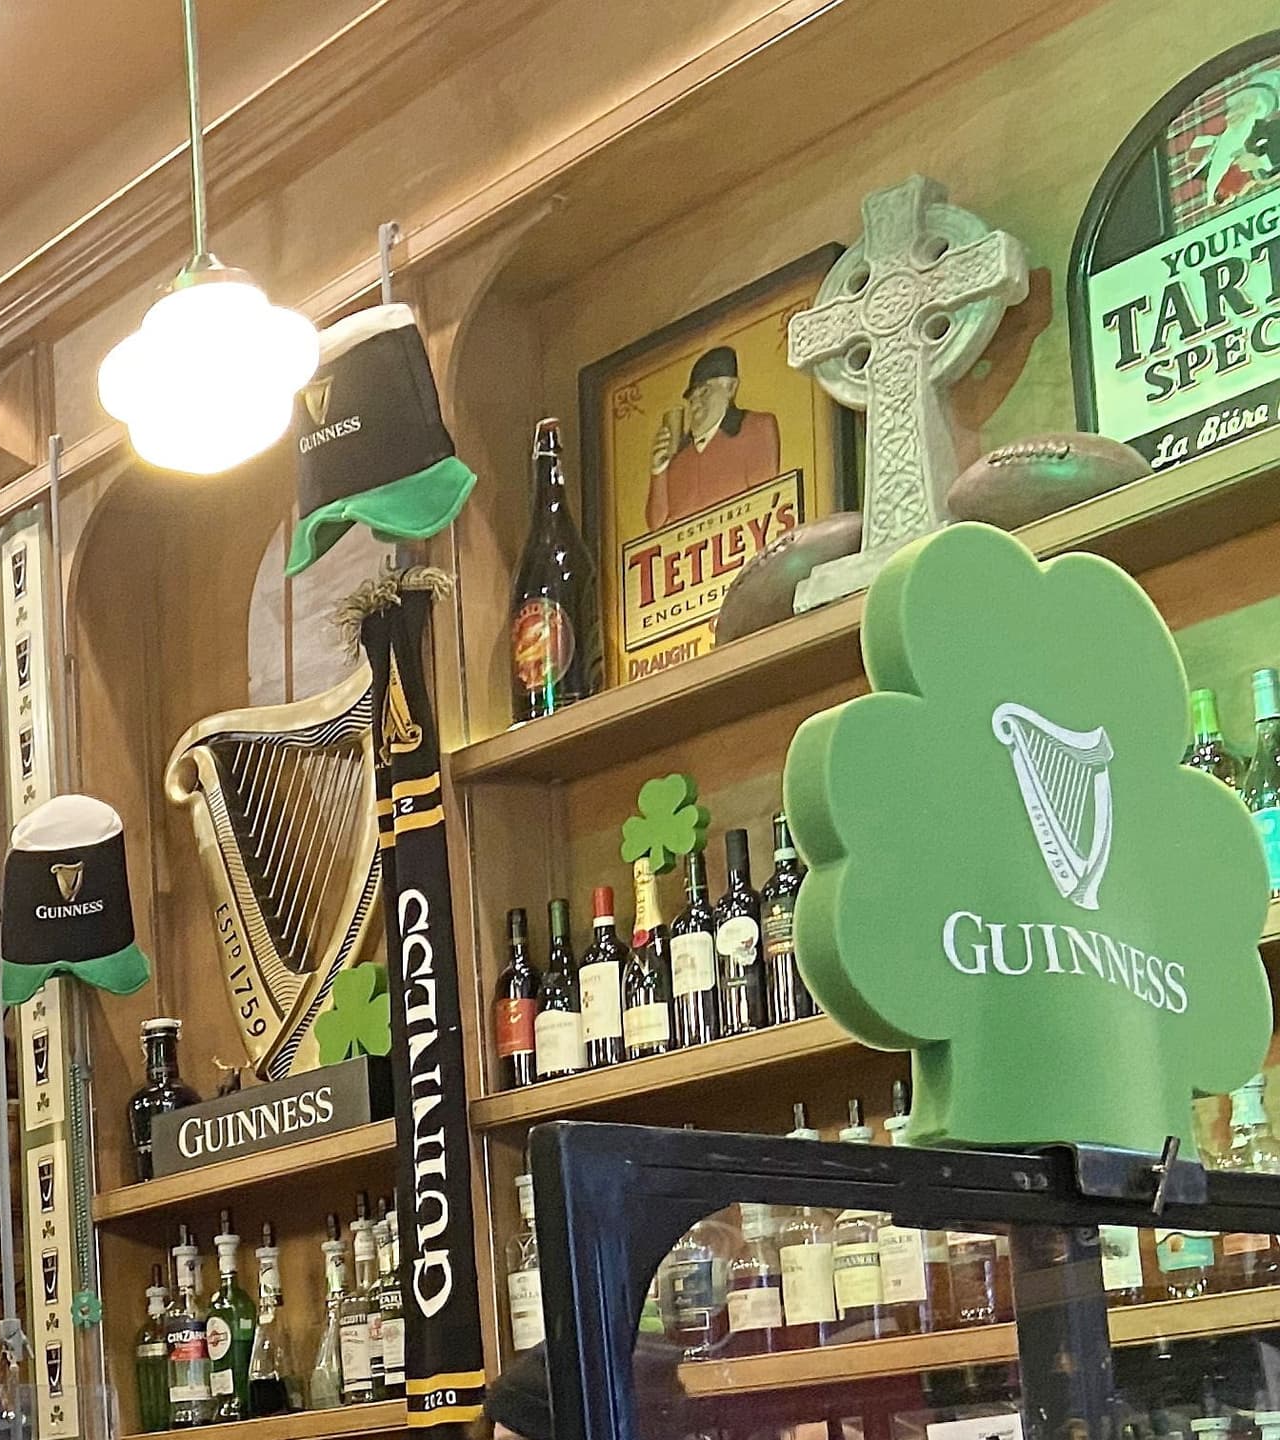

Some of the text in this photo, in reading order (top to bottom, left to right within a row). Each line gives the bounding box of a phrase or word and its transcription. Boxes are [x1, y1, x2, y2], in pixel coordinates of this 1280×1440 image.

[299, 415, 362, 454] GUINNESS
[1151, 432, 1190, 470] La
[628, 491, 796, 610] TETLEY'S
[628, 636, 702, 683] DRAUGHT
[35, 899, 105, 921] GUINNESS
[942, 909, 1189, 1014] GUINNESS
[228, 964, 268, 1038] 1759
[177, 1086, 335, 1160] GUINNESS
[396, 887, 455, 1319] GUINNESS
[423, 1388, 458, 1412] 2020
